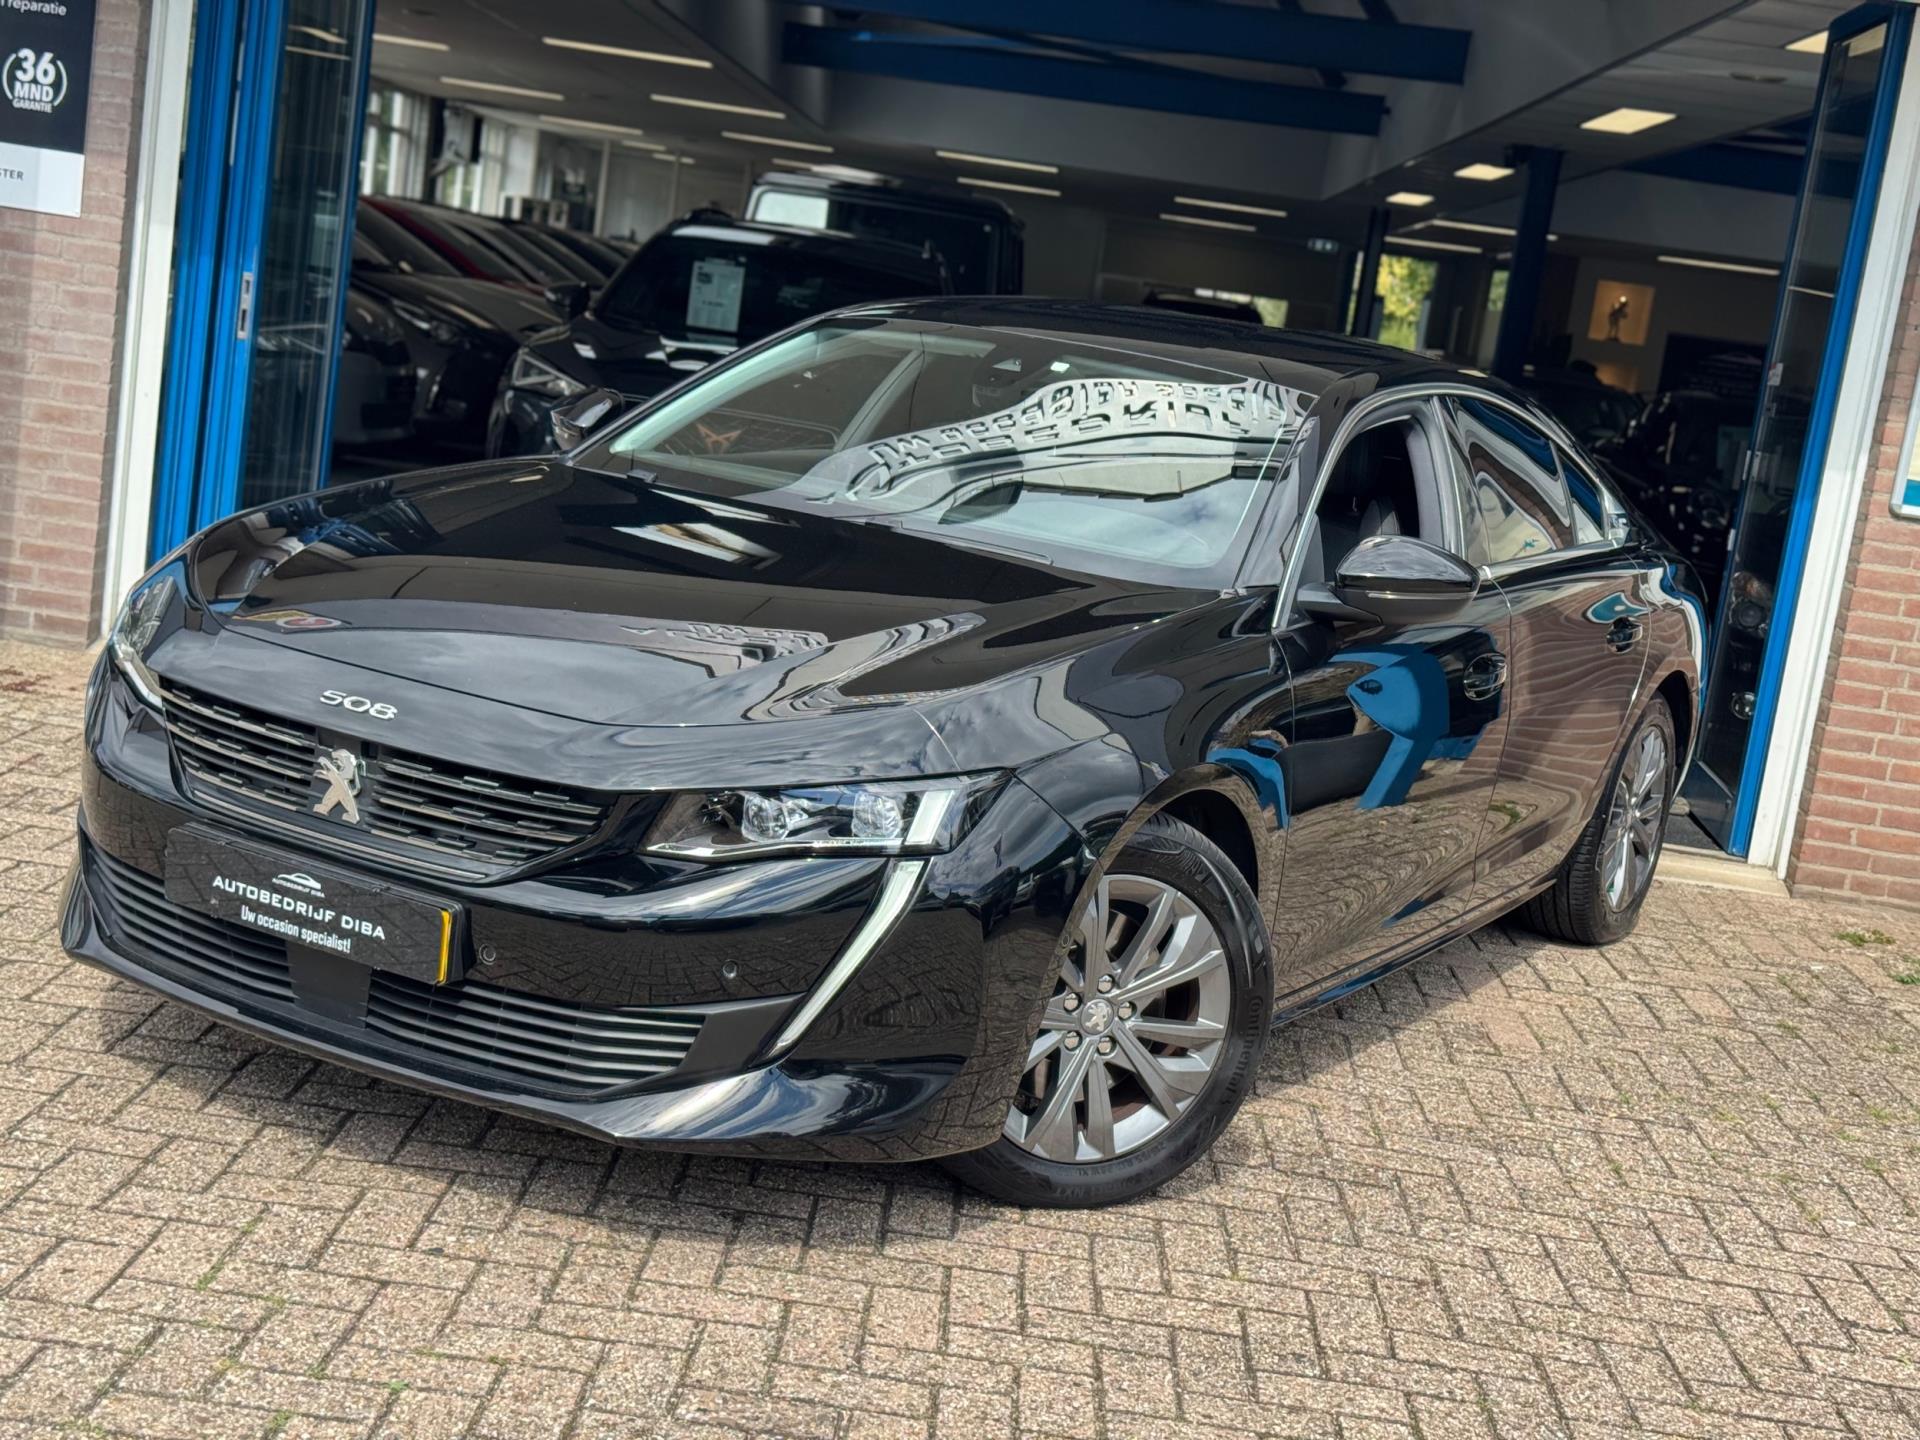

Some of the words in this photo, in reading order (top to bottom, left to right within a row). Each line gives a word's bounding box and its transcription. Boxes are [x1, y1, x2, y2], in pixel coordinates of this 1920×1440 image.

[7, 0, 67, 16] reparatie
[15, 48, 56, 85] 36
[14, 81, 54, 102] MND
[12, 98, 53, 113] GARANTIE
[0, 167, 24, 181] TER
[320, 690, 398, 719] 508
[212, 875, 336, 923] AUTOBEDRIJF
[340, 915, 386, 940] DIBA
[240, 904, 256, 924] Uw
[257, 914, 300, 937] occasion
[300, 927, 351, 954] specialist!
